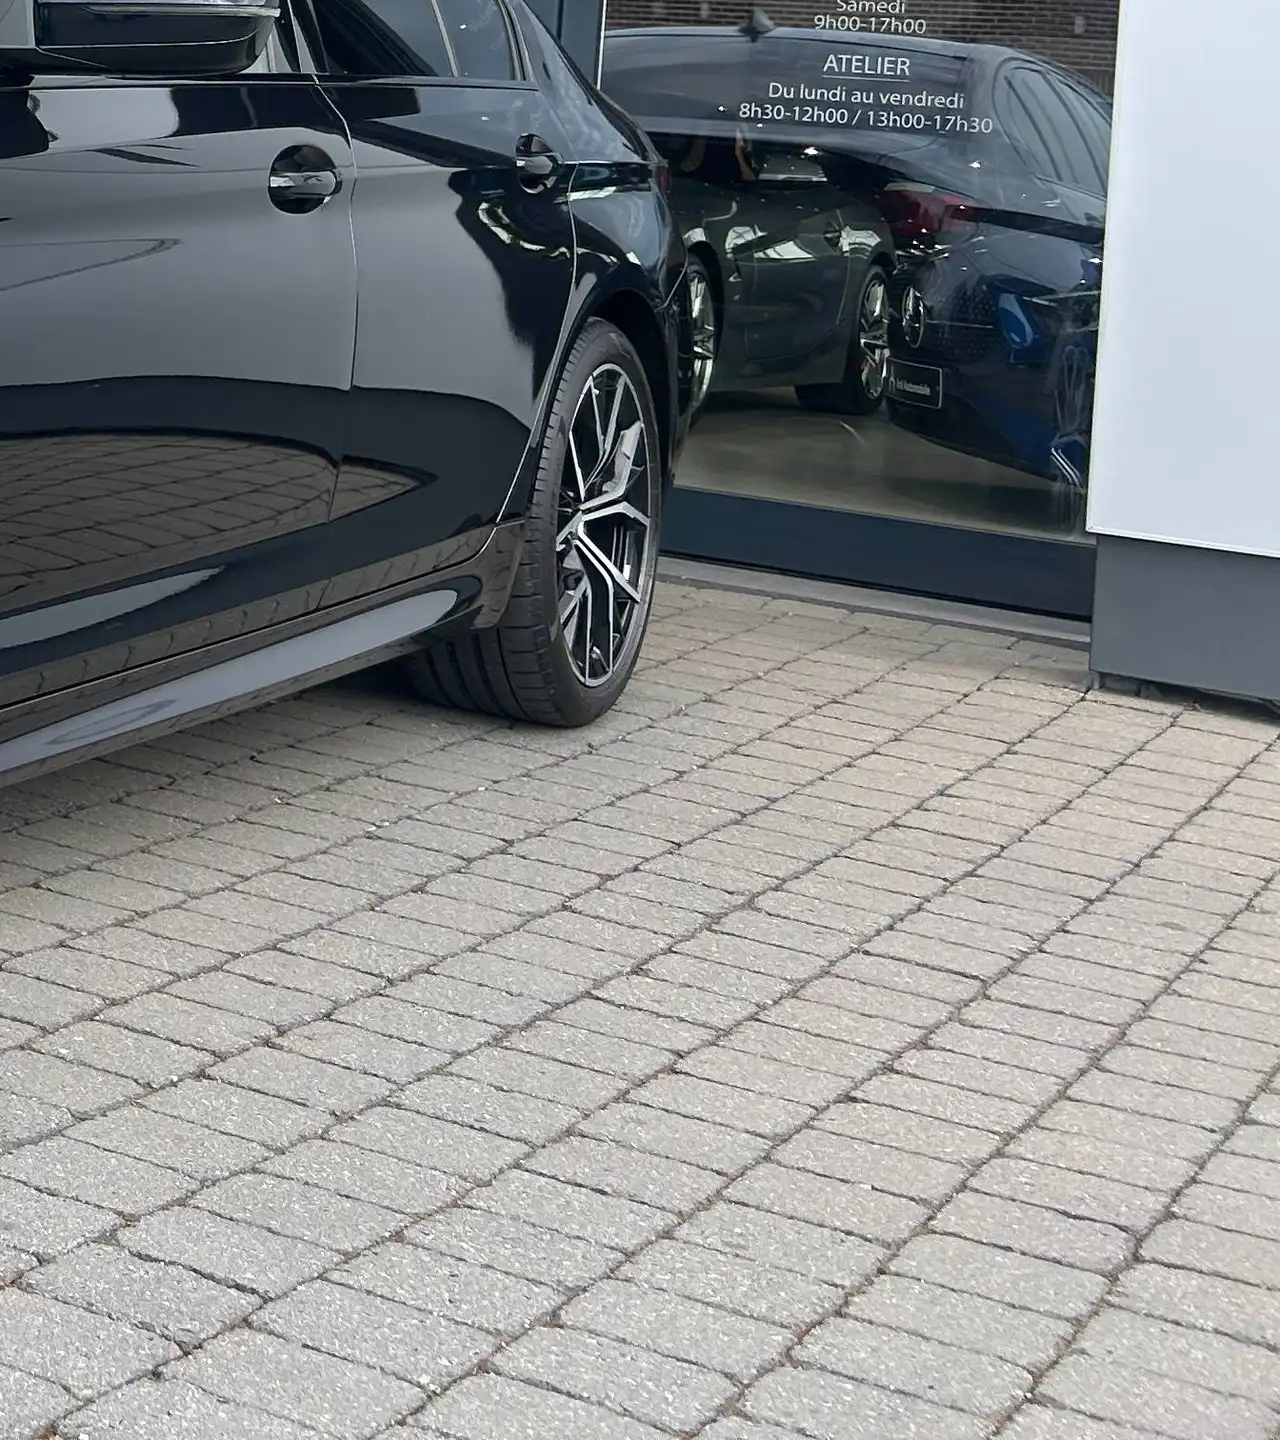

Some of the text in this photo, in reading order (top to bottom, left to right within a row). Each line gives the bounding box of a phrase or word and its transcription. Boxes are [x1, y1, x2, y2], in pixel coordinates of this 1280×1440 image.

[813, 15, 927, 34] 9h00-17h00
[823, 54, 910, 76] ATELIER
[768, 83, 965, 109] Du lundi au vendredi
[739, 103, 848, 124] 8h30-12h00
[867, 110, 993, 133] 13h00-17h30
